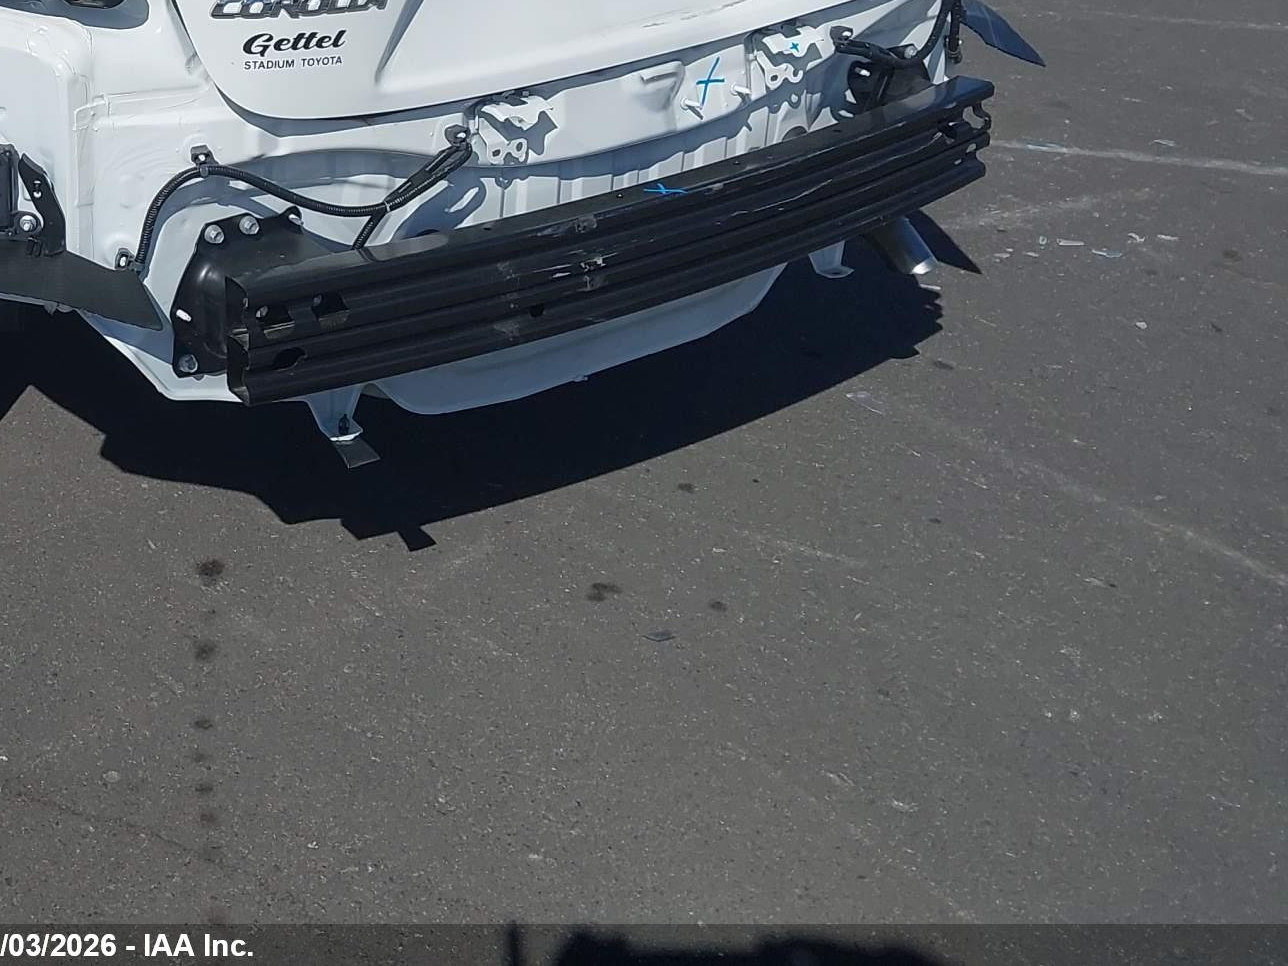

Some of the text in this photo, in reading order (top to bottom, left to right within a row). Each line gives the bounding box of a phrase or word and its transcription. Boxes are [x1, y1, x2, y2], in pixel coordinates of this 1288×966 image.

[242, 29, 347, 57] Gettel
[244, 55, 343, 70] STADIUM TOYOTA
